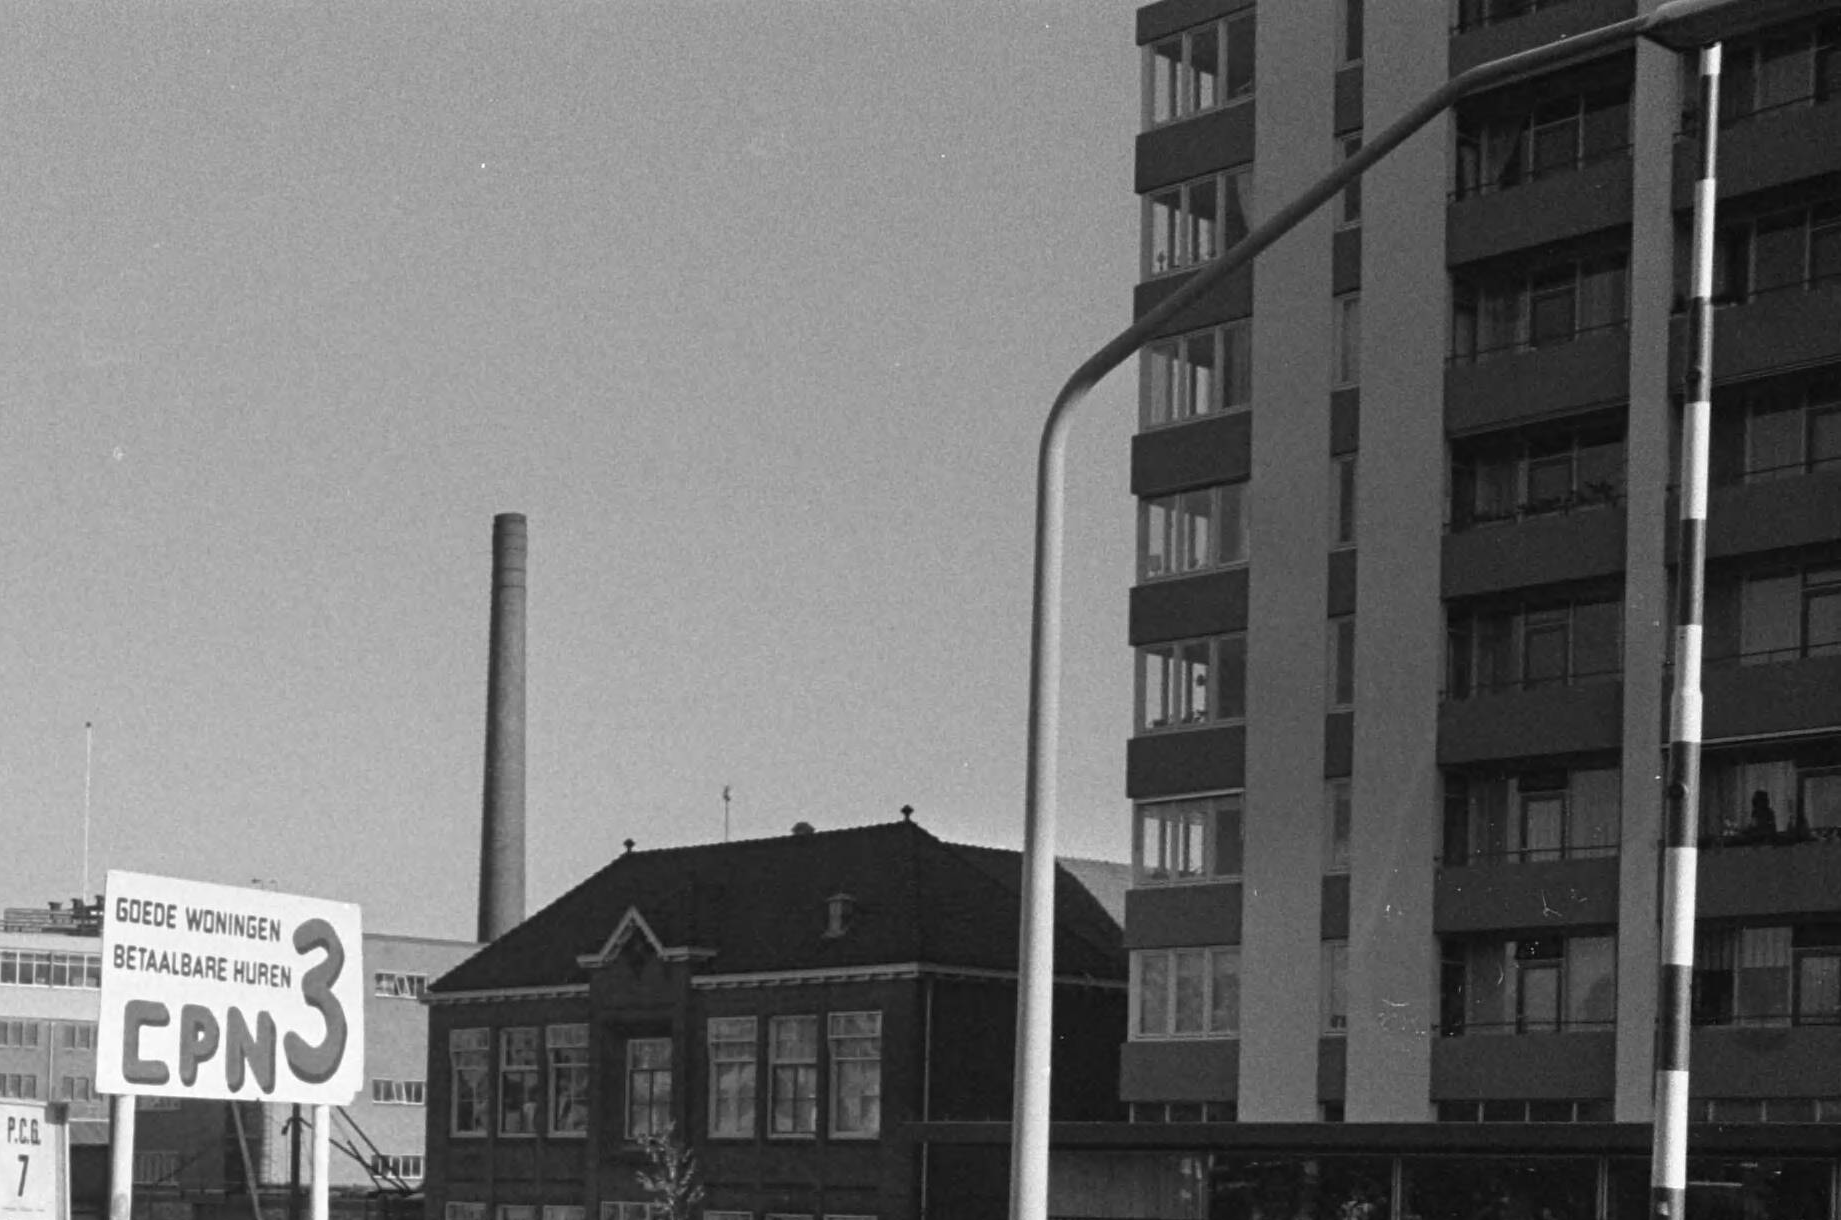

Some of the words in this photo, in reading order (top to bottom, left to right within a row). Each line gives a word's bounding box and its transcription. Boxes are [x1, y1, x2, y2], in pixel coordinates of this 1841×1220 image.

[116, 897, 177, 928] GOEDE
[186, 907, 281, 941] WONINGEN
[113, 944, 228, 981] BETAALBARE
[233, 960, 291, 988] HUREN
[283, 918, 348, 1084] 3
[122, 1000, 277, 1094] CPN
[17, 1154, 29, 1197] 7
